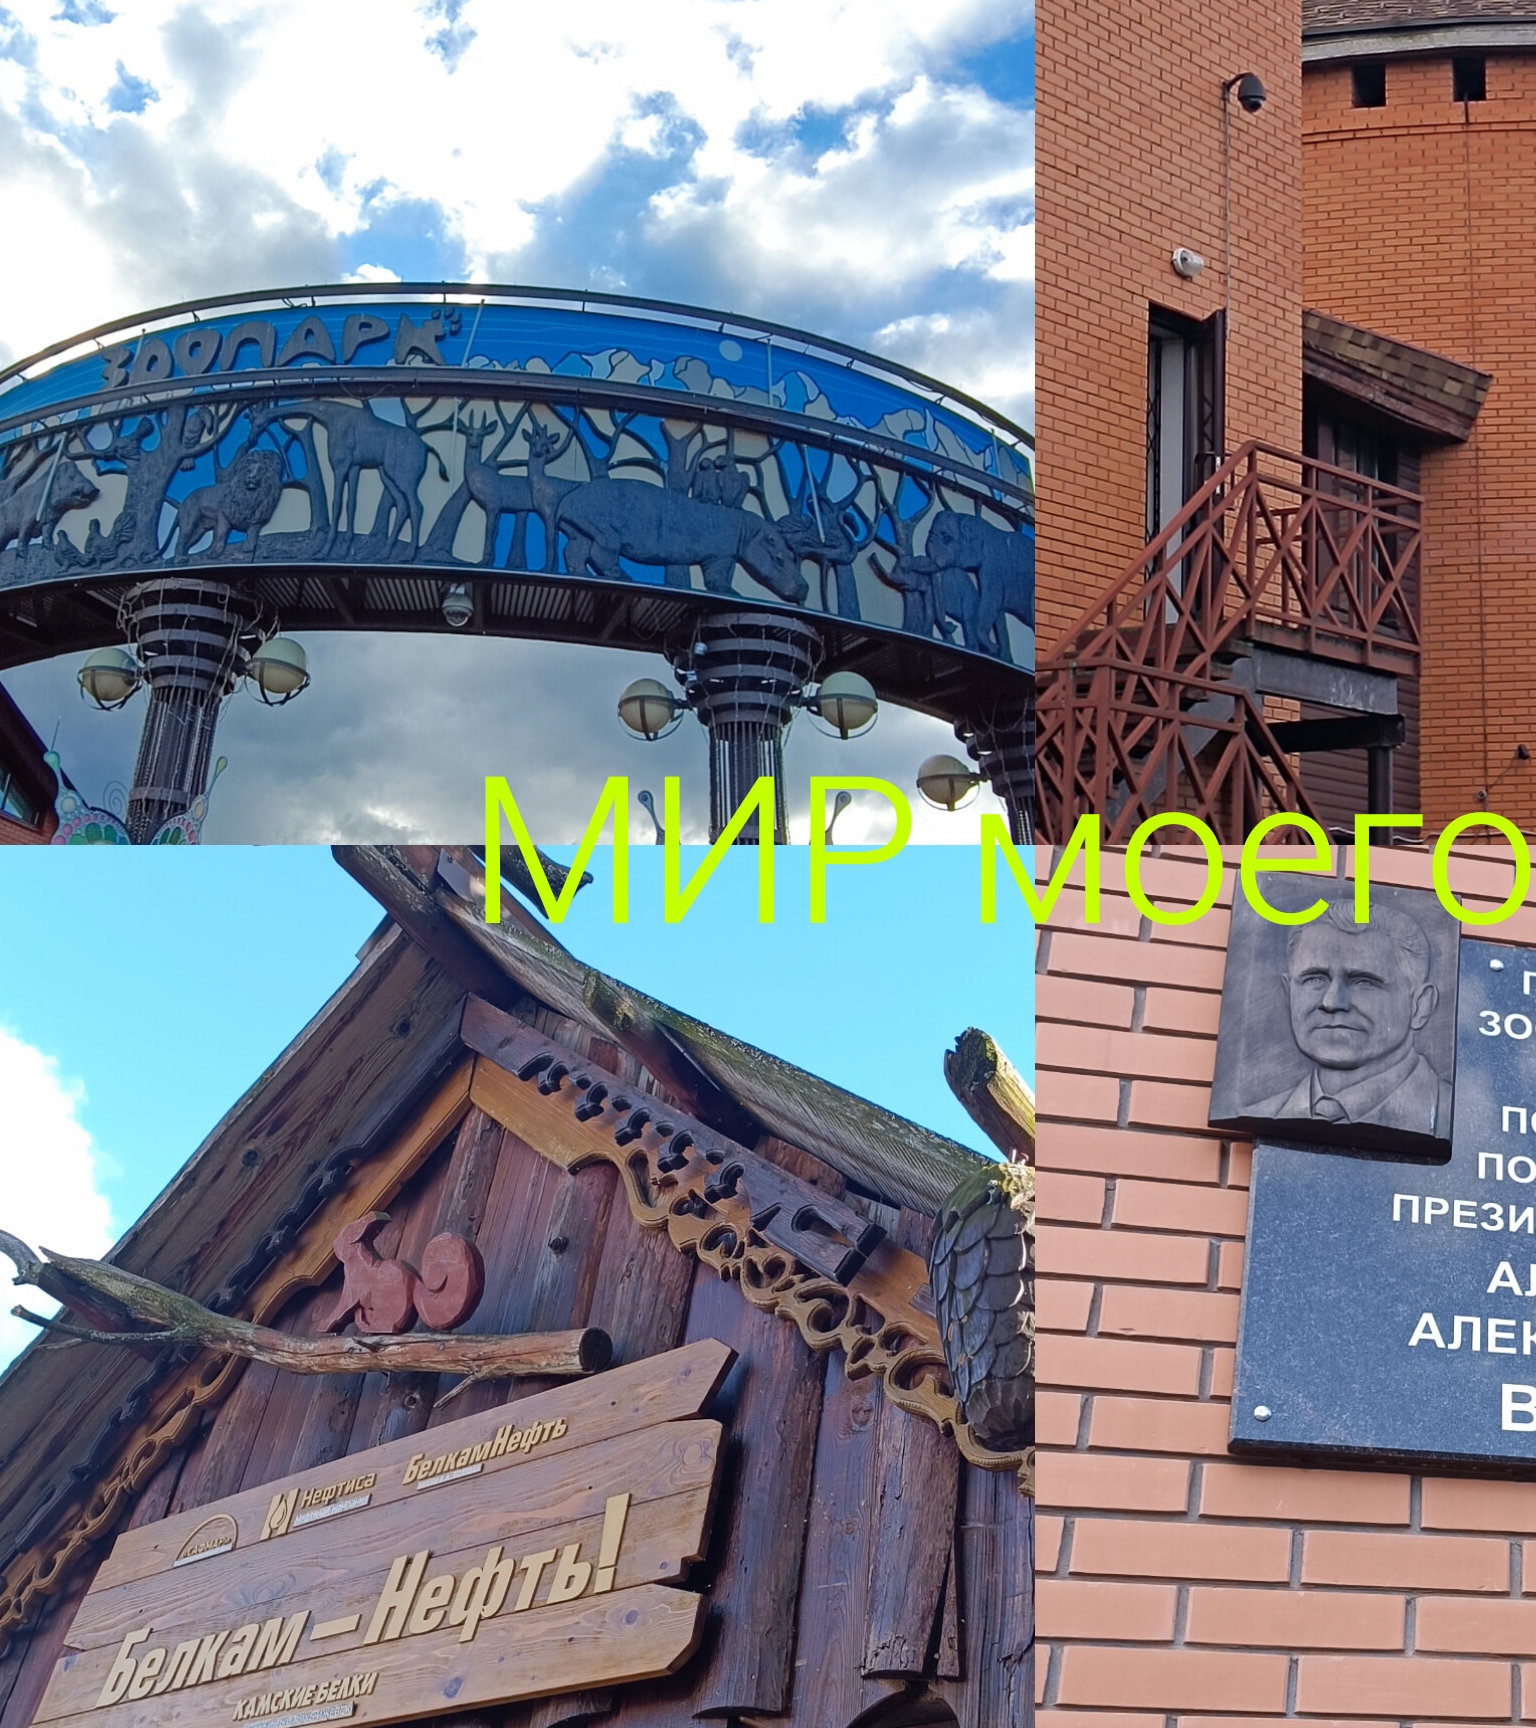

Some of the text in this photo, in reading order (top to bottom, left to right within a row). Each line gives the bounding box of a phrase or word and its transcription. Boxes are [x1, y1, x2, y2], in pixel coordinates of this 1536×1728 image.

[101, 312, 450, 389] ЗООПАРК
[402, 1418, 569, 1485] БелкамНефть
[301, 1472, 377, 1508] Нефтиса
[231, 1683, 318, 1721] КАМСКИЕ
[315, 1671, 380, 1705] БЕЛКИ
